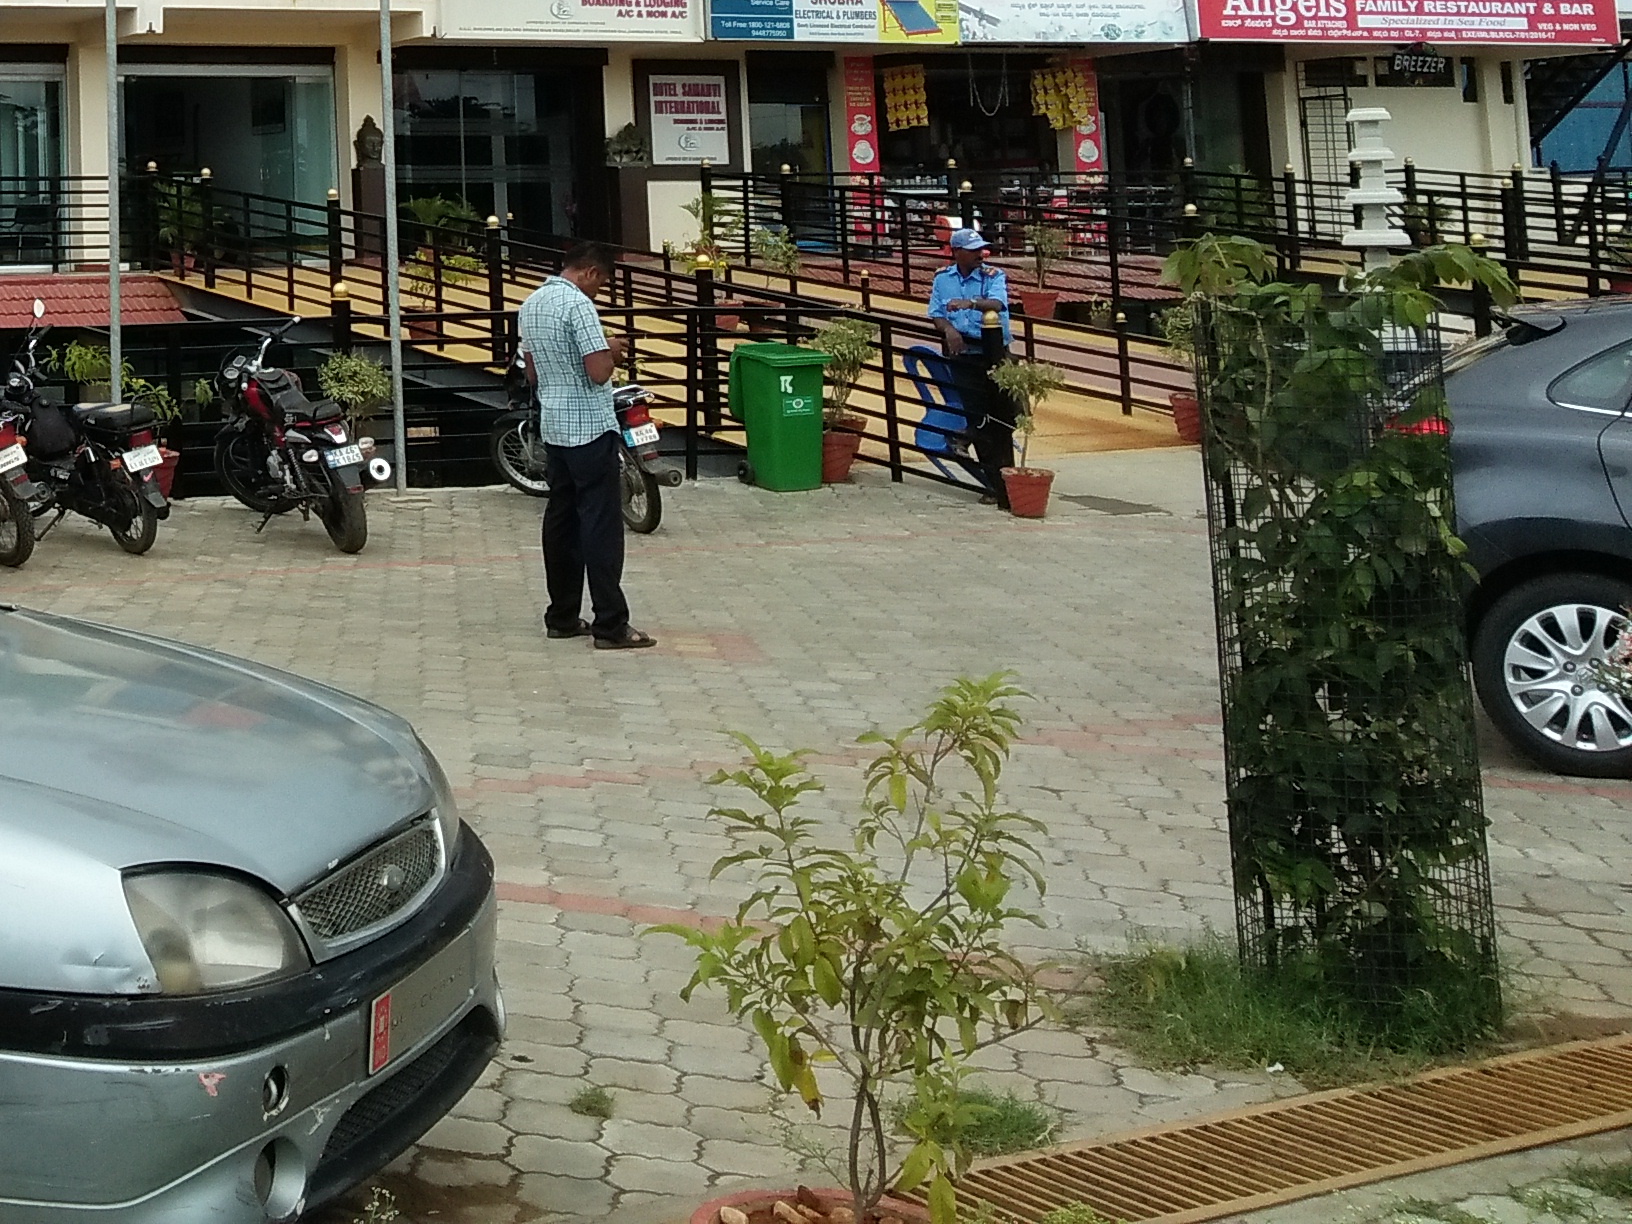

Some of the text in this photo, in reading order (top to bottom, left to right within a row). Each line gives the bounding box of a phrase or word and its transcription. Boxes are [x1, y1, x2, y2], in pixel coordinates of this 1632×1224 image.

[1355, 0, 1595, 16] FAMILY RESTAURANT & BAR
[617, 9, 634, 18] A/C
[646, 10, 667, 18] NON
[670, 11, 687, 19] A/C
[795, 10, 834, 20] ELECTRICAL
[842, 11, 877, 21] PLUMBERS
[1380, 16, 1507, 27] Specialized In Sea Food
[1537, 22, 1554, 31] VEG
[1581, 23, 1597, 31] VEG
[1394, 55, 1446, 73] BREEZER
